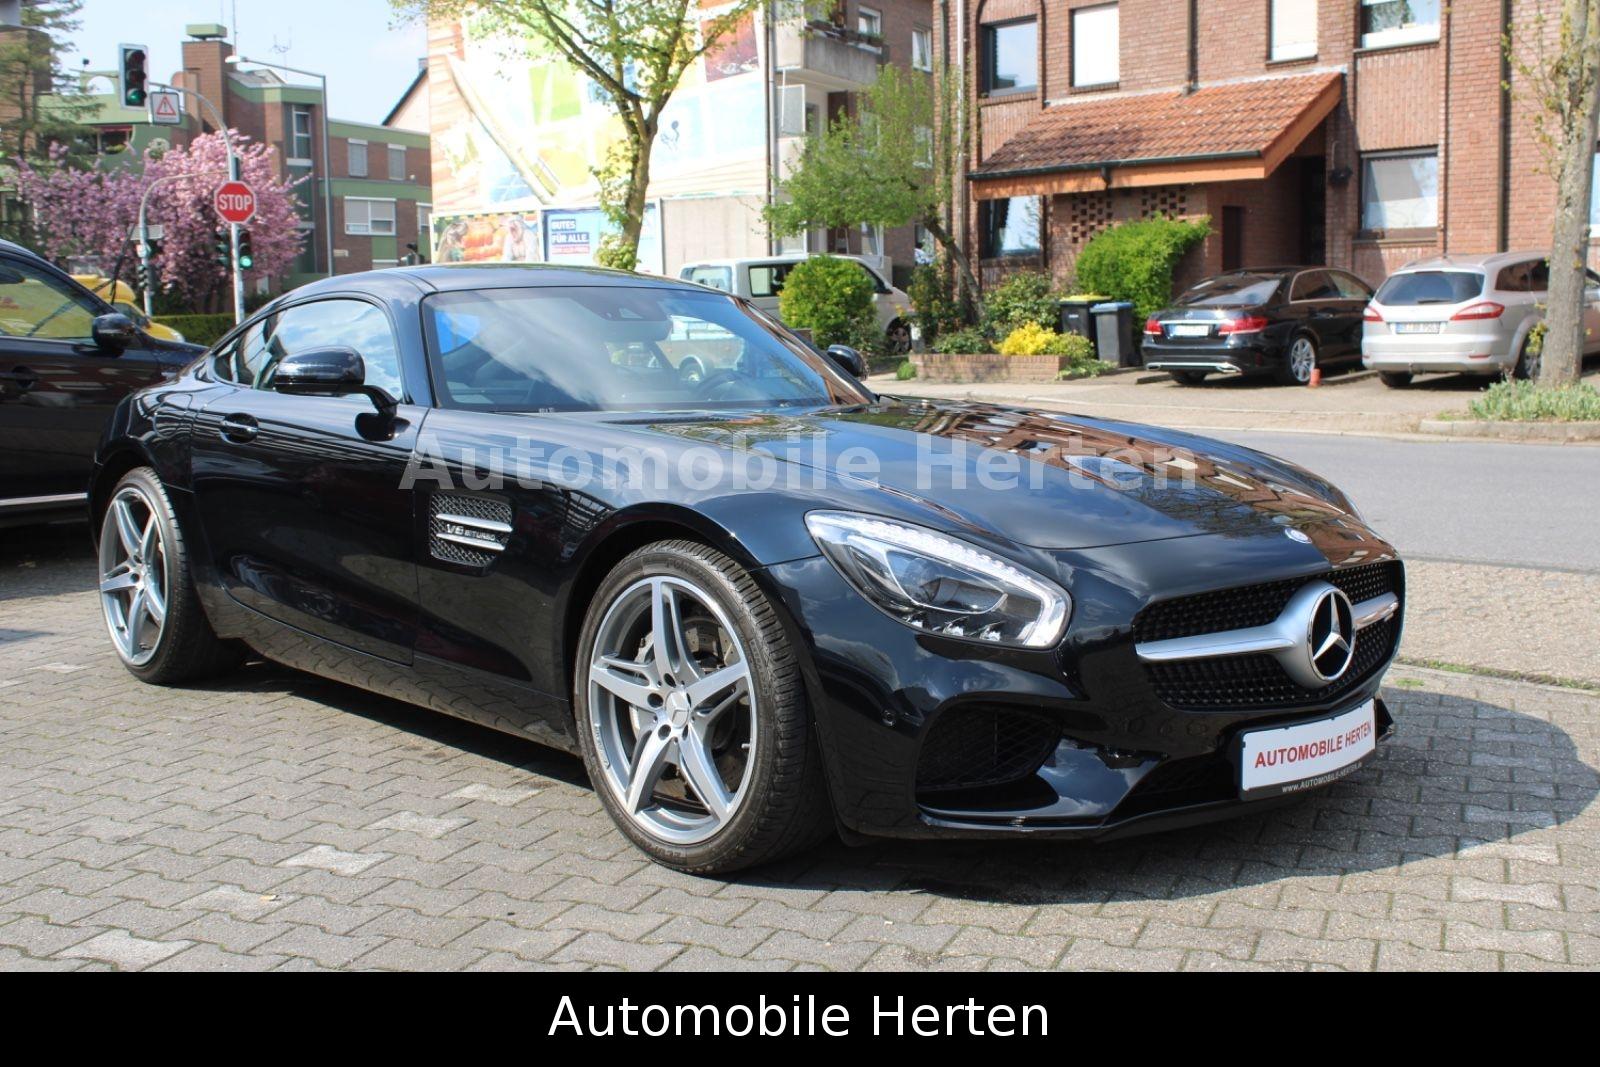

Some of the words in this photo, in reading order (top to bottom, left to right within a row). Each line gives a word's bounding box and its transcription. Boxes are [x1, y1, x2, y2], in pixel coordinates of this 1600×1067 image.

[219, 194, 252, 211] STOP
[1254, 734, 1343, 769] AUTOMOBILE
[1344, 719, 1372, 748] HERTEN
